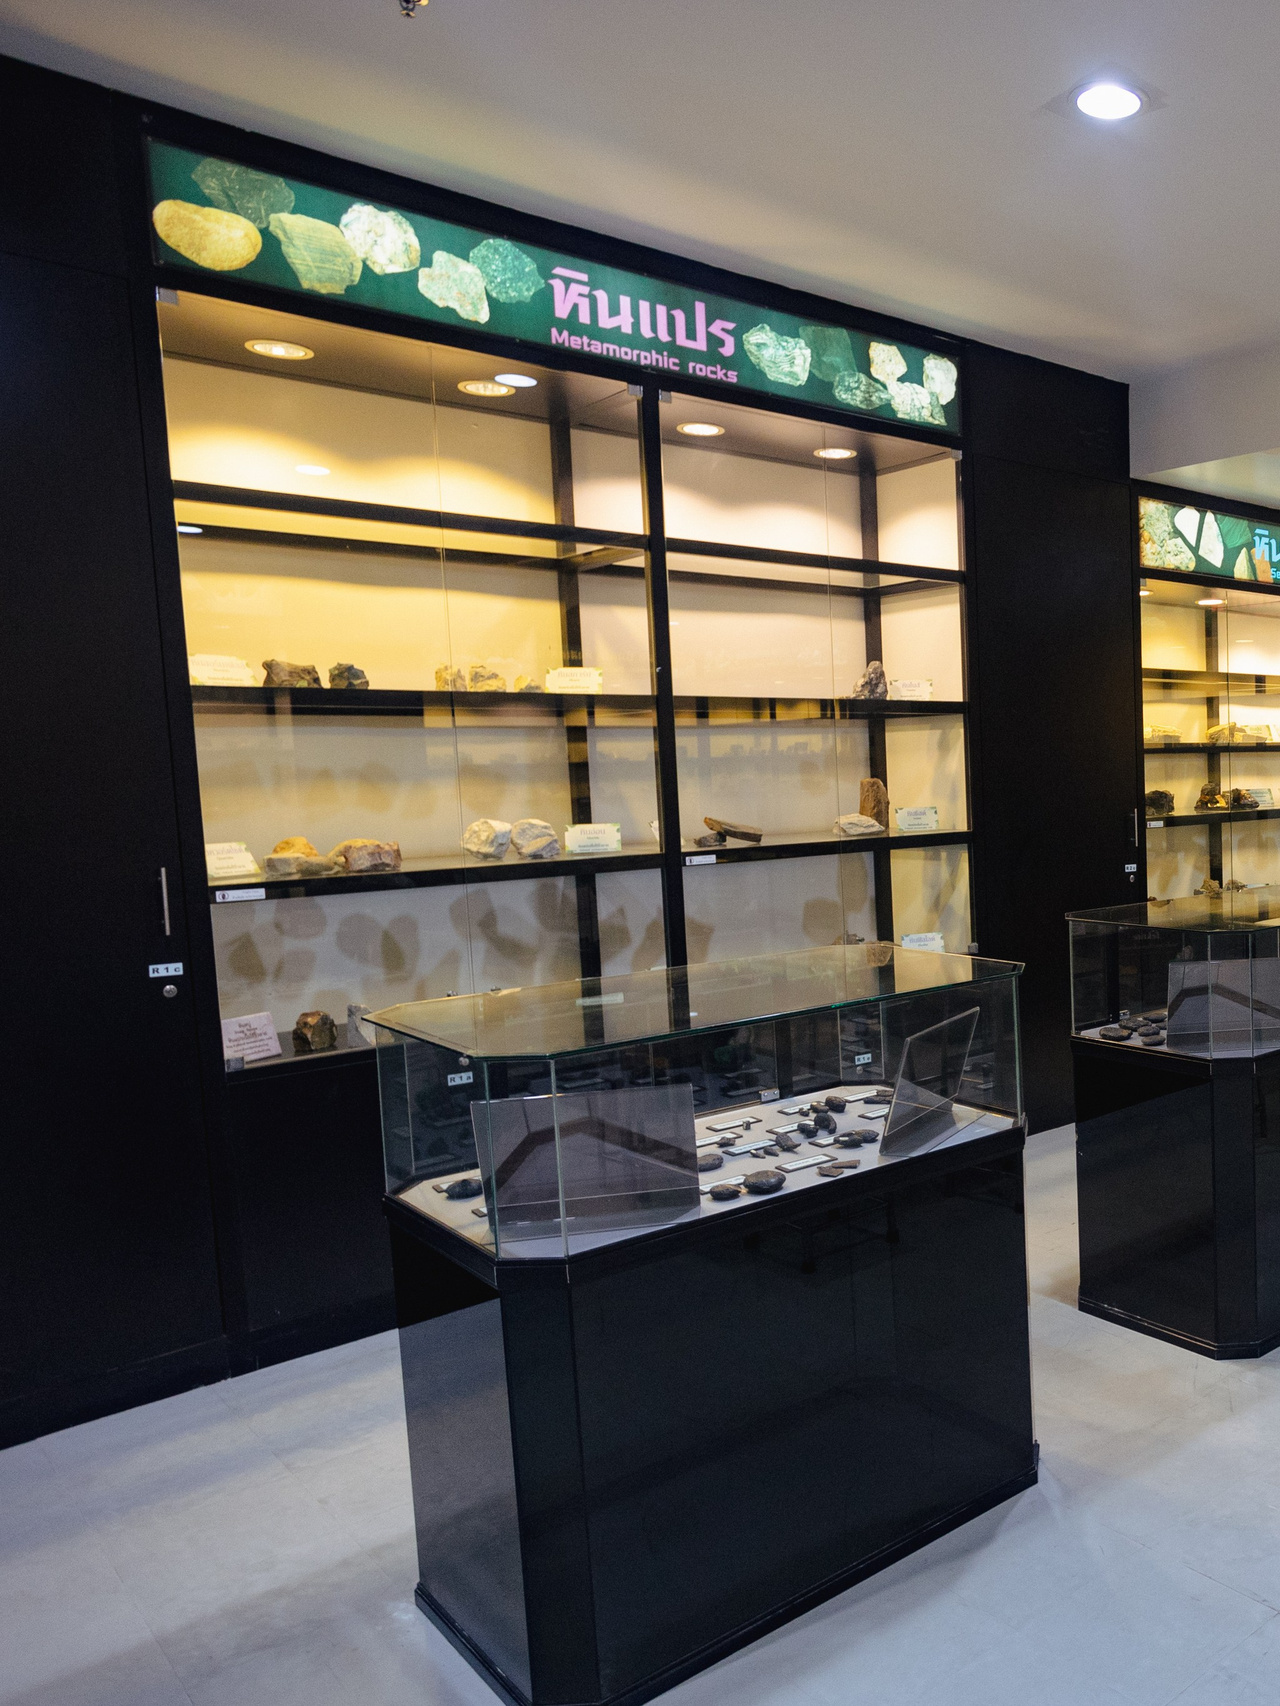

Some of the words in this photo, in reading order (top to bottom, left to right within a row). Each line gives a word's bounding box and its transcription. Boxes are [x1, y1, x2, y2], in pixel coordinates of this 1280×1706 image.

[548, 266, 738, 358] หินแปร
[550, 326, 681, 371] Metamorphic
[688, 360, 739, 384] rocks
